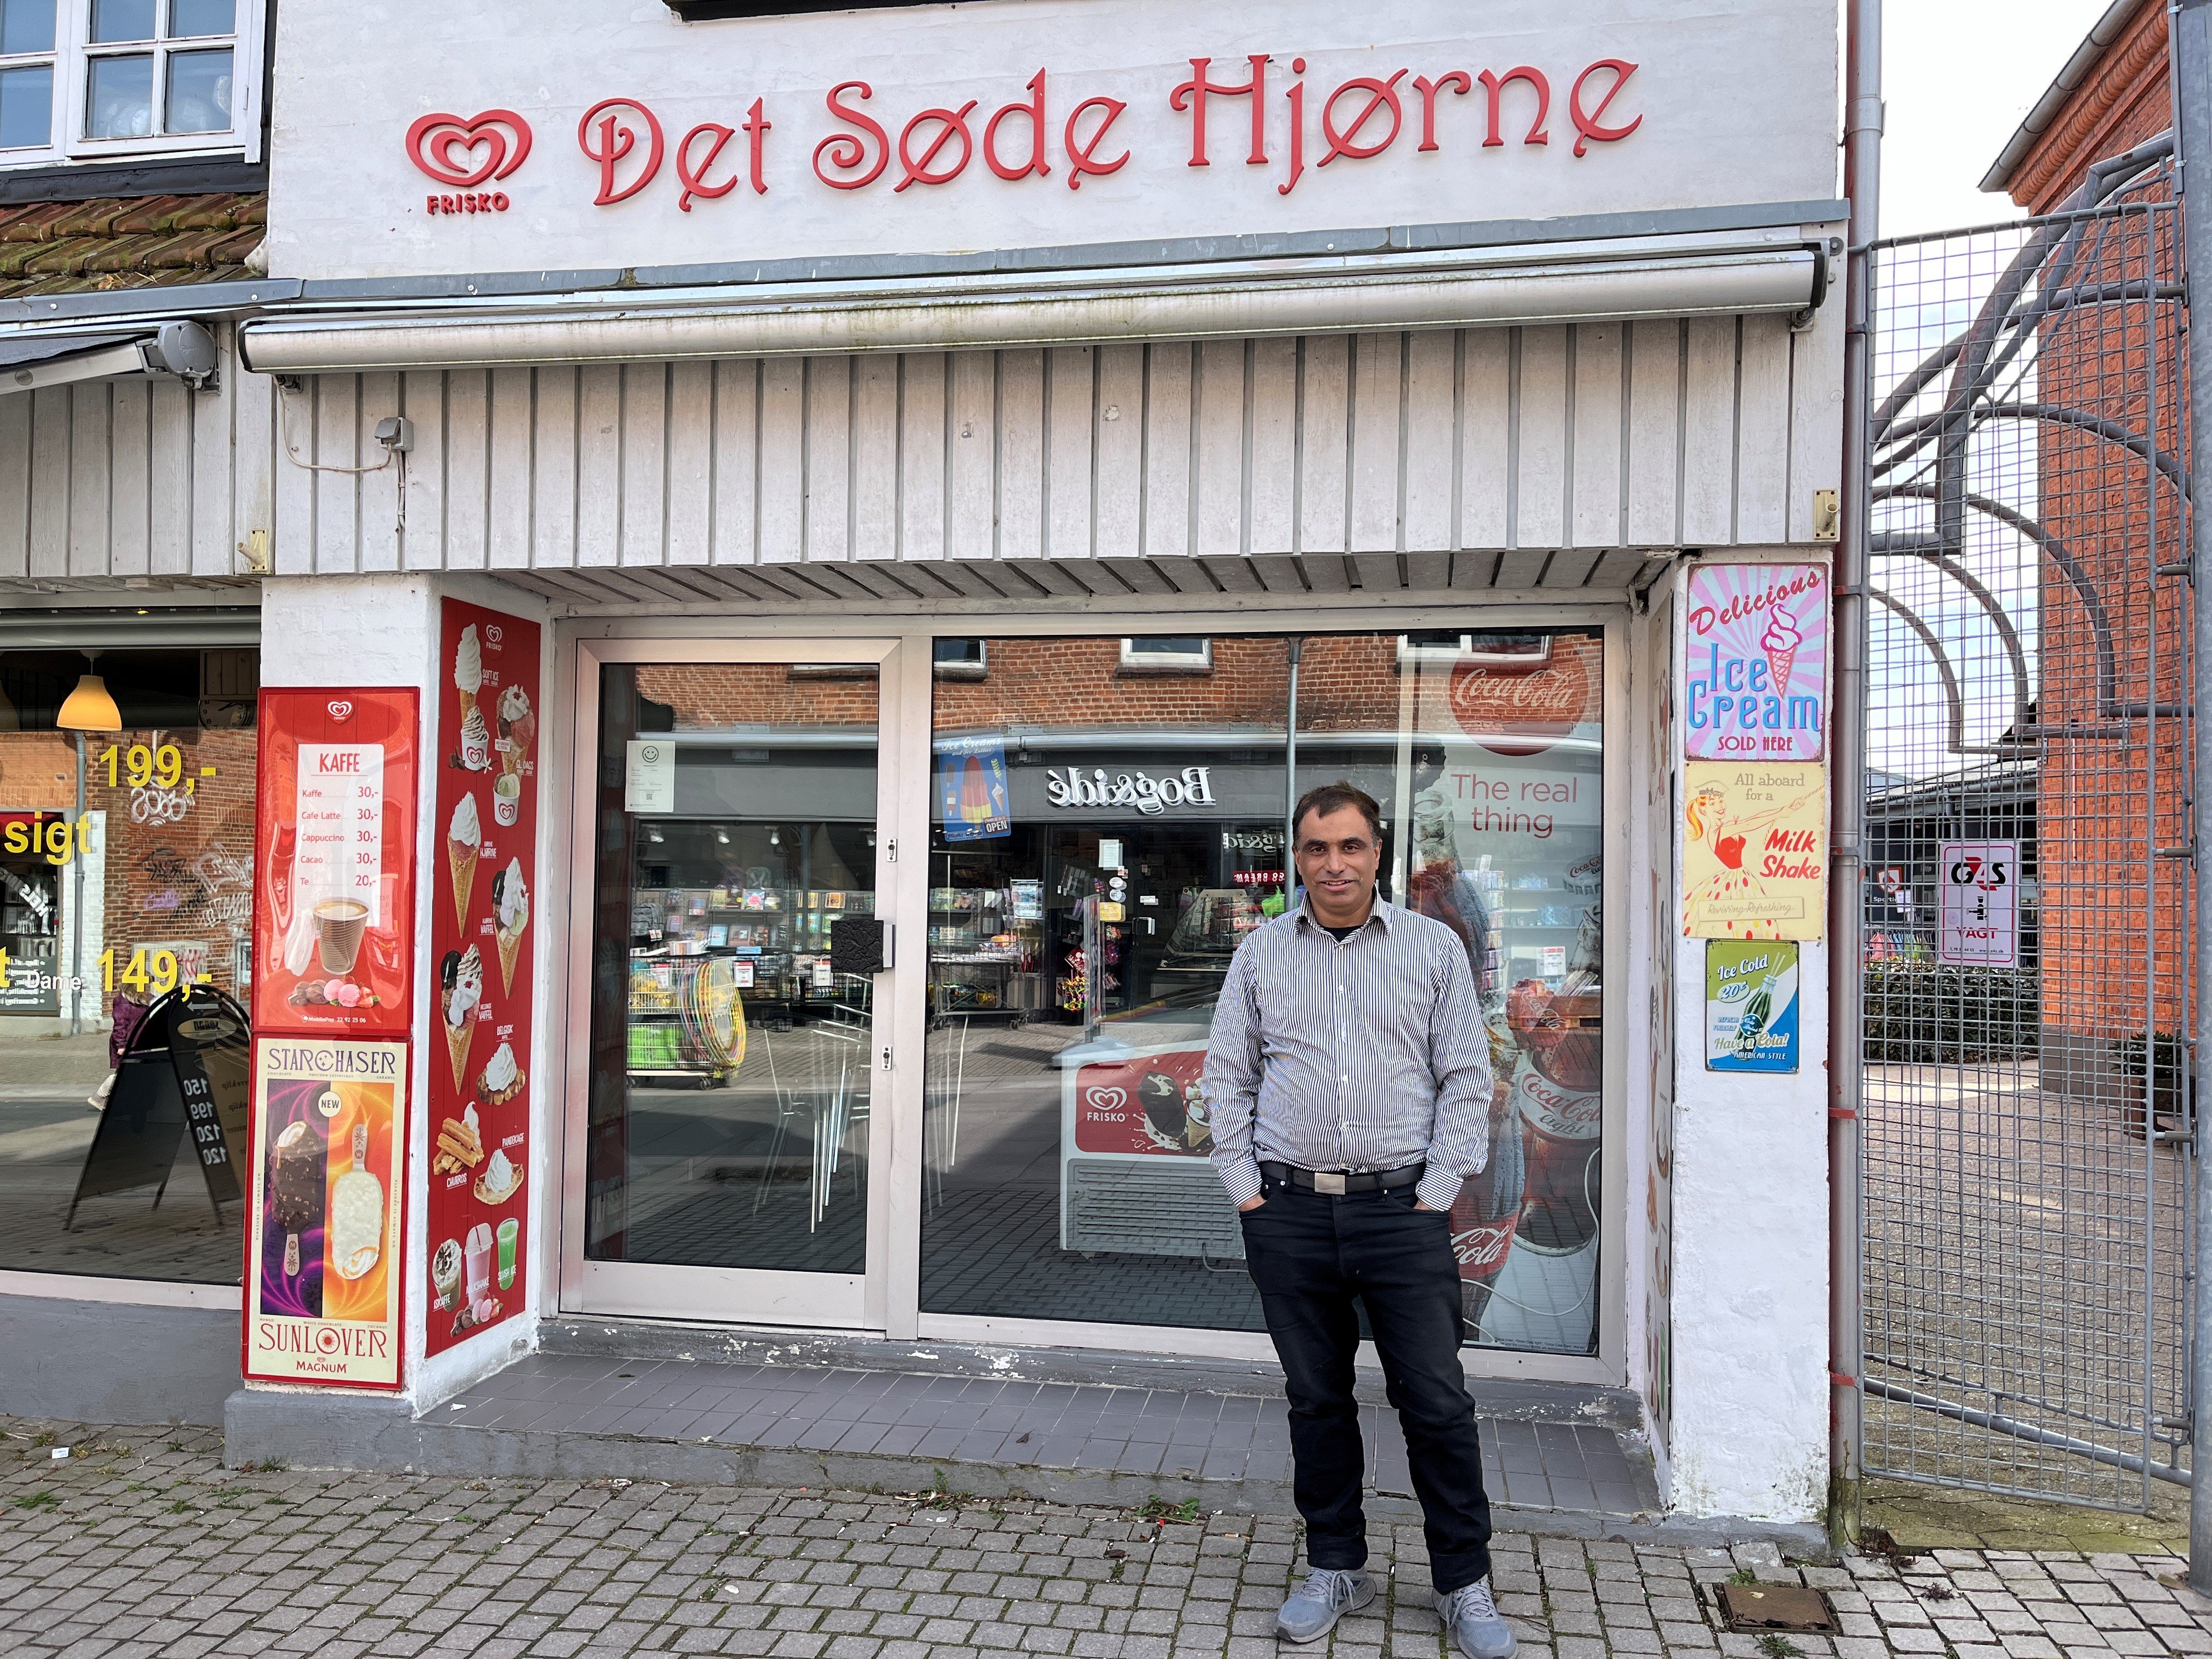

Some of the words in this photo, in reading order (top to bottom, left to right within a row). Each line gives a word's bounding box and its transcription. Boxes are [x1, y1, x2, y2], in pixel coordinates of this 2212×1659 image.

[578, 97, 771, 212] Det
[812, 67, 1130, 193] Søde
[1170, 54, 1643, 195] Hjørne
[426, 194, 510, 216] FRISKO
[1689, 571, 1820, 635] Delicious
[486, 641, 501, 651] FRISKO
[482, 669, 493, 680] SOFT
[1710, 642, 1768, 692] Ice
[1688, 680, 1821, 731] Cream
[941, 740, 960, 751] Ice
[962, 737, 1001, 748] Creams
[1718, 736, 1756, 751] SOLD
[1763, 736, 1792, 751] HERE
[100, 744, 216, 795] 199,-
[320, 753, 360, 772] KAFFE
[1734, 773, 1754, 786] All
[1759, 773, 1805, 786] aboard
[302, 789, 322, 798] Kaffe
[358, 787, 379, 799] 30,-
[1451, 774, 1510, 800] The
[1521, 777, 1577, 803] real
[1746, 788, 1763, 800] for
[1766, 793, 1774, 801] a
[357, 809, 378, 821] 30,-
[1471, 805, 1554, 839] thing
[986, 820, 1008, 833] OPEN
[4, 811, 92, 865] sigt
[301, 834, 345, 843] Cappuccino
[357, 831, 377, 843] 30,-
[1764, 828, 1816, 852] Milk
[356, 853, 377, 865] 30,-
[1759, 854, 1821, 879] Shake
[356, 875, 376, 888] 20,-
[1951, 856, 2006, 891] G4S
[480, 924, 494, 934] VAFFEL
[1956, 927, 1999, 939] VAGT
[1717, 966, 1736, 980] Ice
[1740, 953, 1769, 975] Cold
[26, 970, 82, 990] Dame
[97, 949, 212, 1002] 149,-
[478, 1010, 493, 1020] VAFFEL
[496, 1024, 514, 1036] BELGISK
[1714, 1037, 1743, 1050] Have
[1746, 1040, 1754, 1049] a
[1756, 1032, 1790, 1048] Cola!
[268, 1048, 396, 1074] STARCHASER
[1734, 1052, 1765, 1060] AMERICAN
[1768, 1052, 1786, 1060] STYLE
[321, 1099, 340, 1108] NEW
[1087, 1111, 1126, 1122] FRISKO
[1538, 1114, 1585, 1135] light
[502, 1132, 524, 1148] PANDEKAGE
[447, 1172, 467, 1188] CHURROS
[434, 1293, 450, 1310] ISKAFFE
[259, 1323, 387, 1358] SUNLOVER
[296, 1360, 347, 1373] MAGNUM
